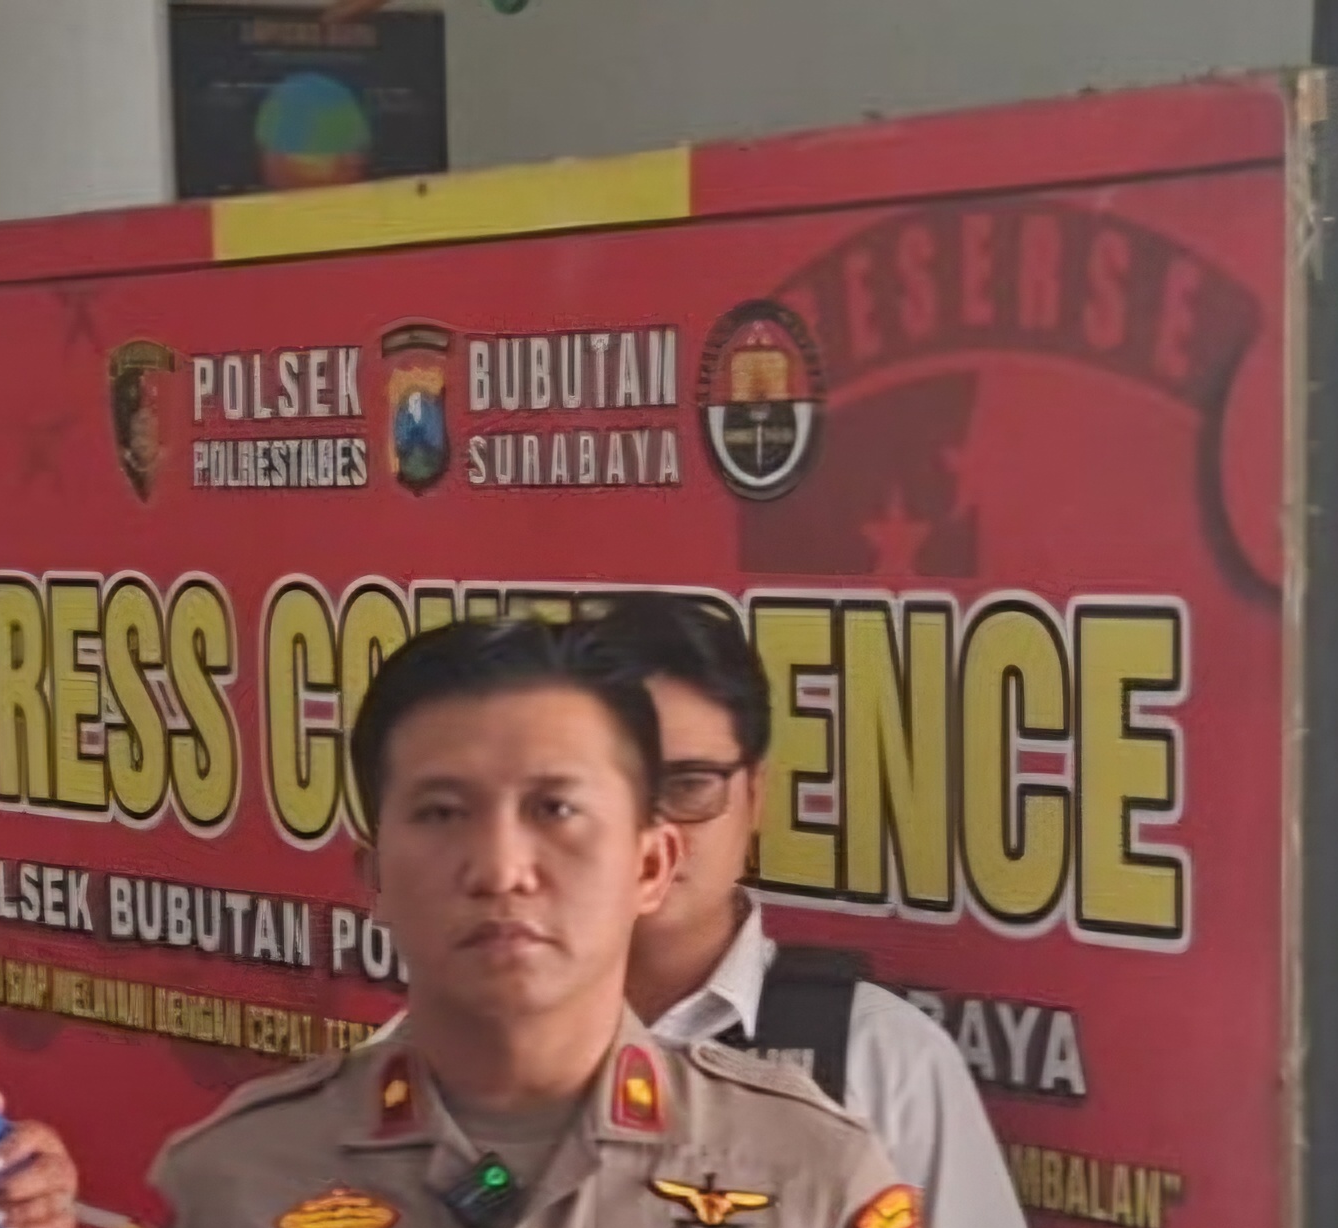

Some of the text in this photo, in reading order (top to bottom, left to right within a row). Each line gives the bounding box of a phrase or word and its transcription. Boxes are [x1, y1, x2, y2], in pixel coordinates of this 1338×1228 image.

[781, 212, 1201, 384] ESERSE
[192, 347, 363, 421] POLSEK
[468, 330, 677, 411] BUBUTAN
[467, 430, 680, 486] SURABAYA
[260, 574, 1191, 954] COENCE
[108, 874, 311, 967] BUBUTAN
